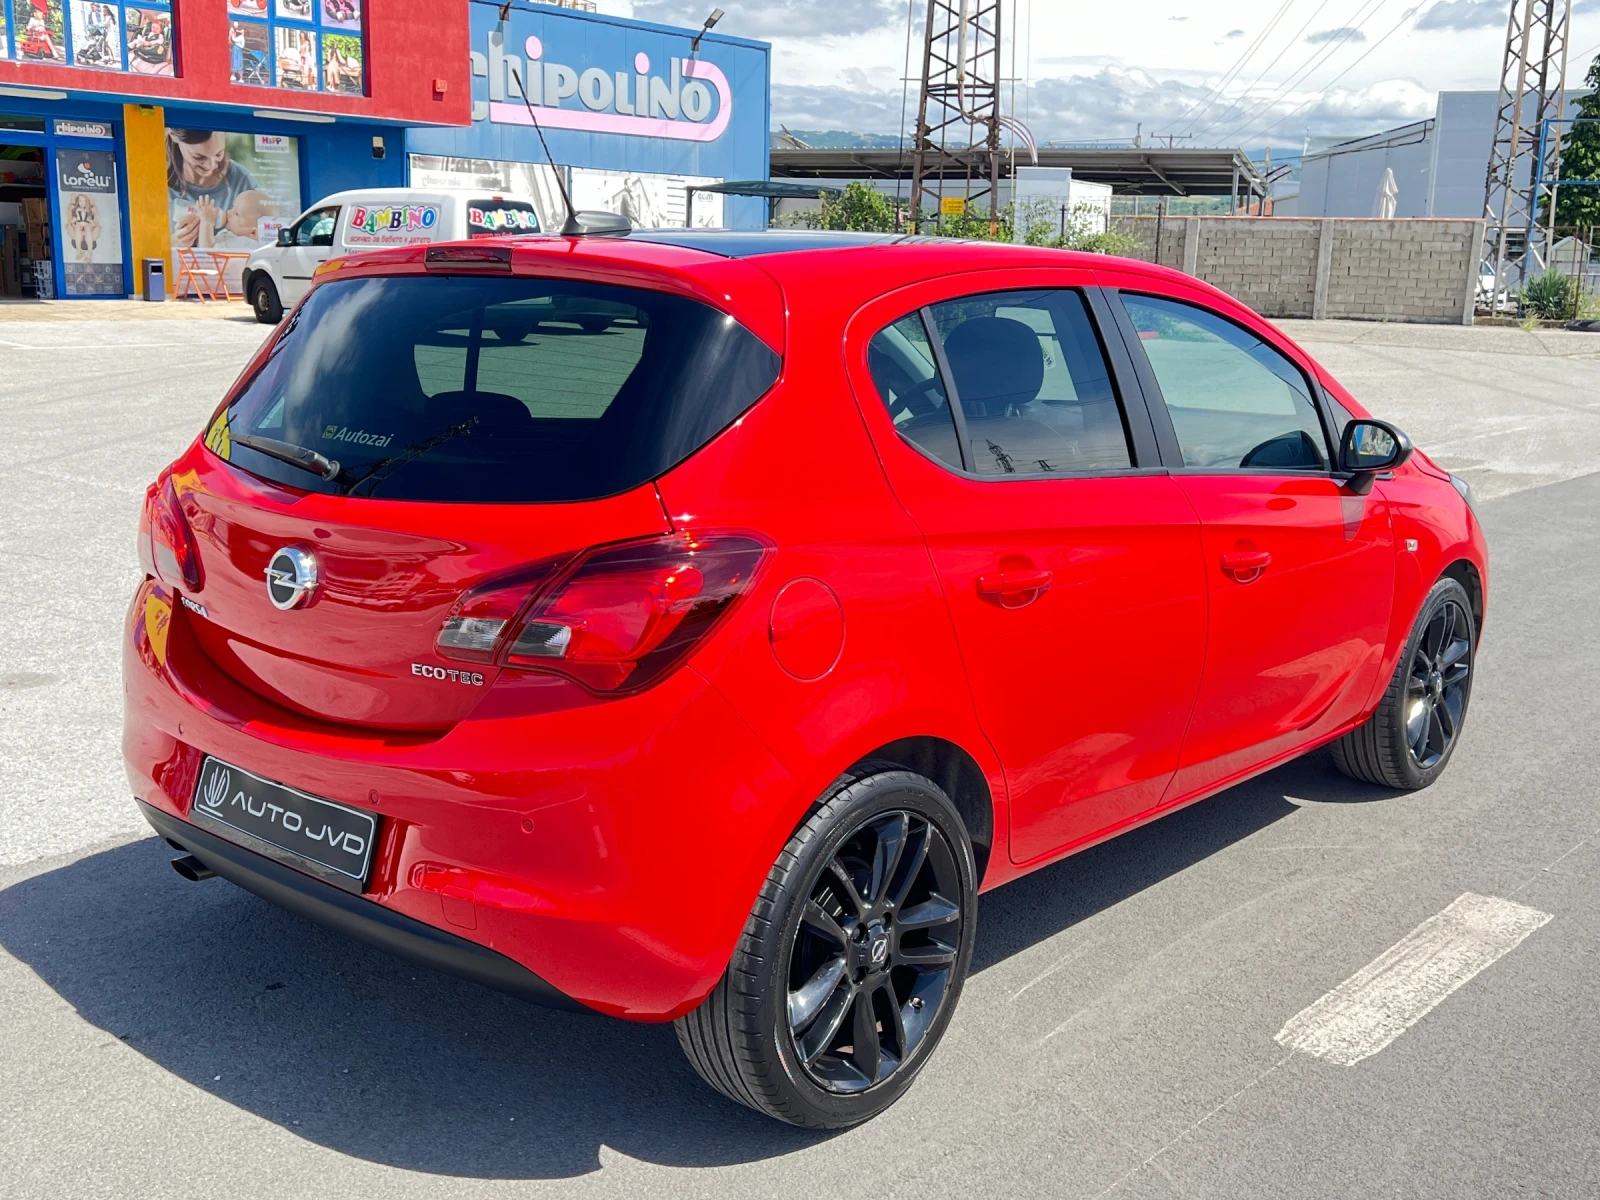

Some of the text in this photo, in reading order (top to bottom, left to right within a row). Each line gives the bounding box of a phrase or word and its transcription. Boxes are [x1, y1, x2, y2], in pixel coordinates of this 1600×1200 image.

[351, 206, 436, 234] BAMBINO
[470, 209, 536, 228] BAMBINO
[381, 235, 403, 243] бебето
[408, 236, 431, 245] детето
[333, 427, 394, 447] Autozai
[411, 663, 484, 686] ECOTEC
[231, 791, 365, 856] AUTO JVD
